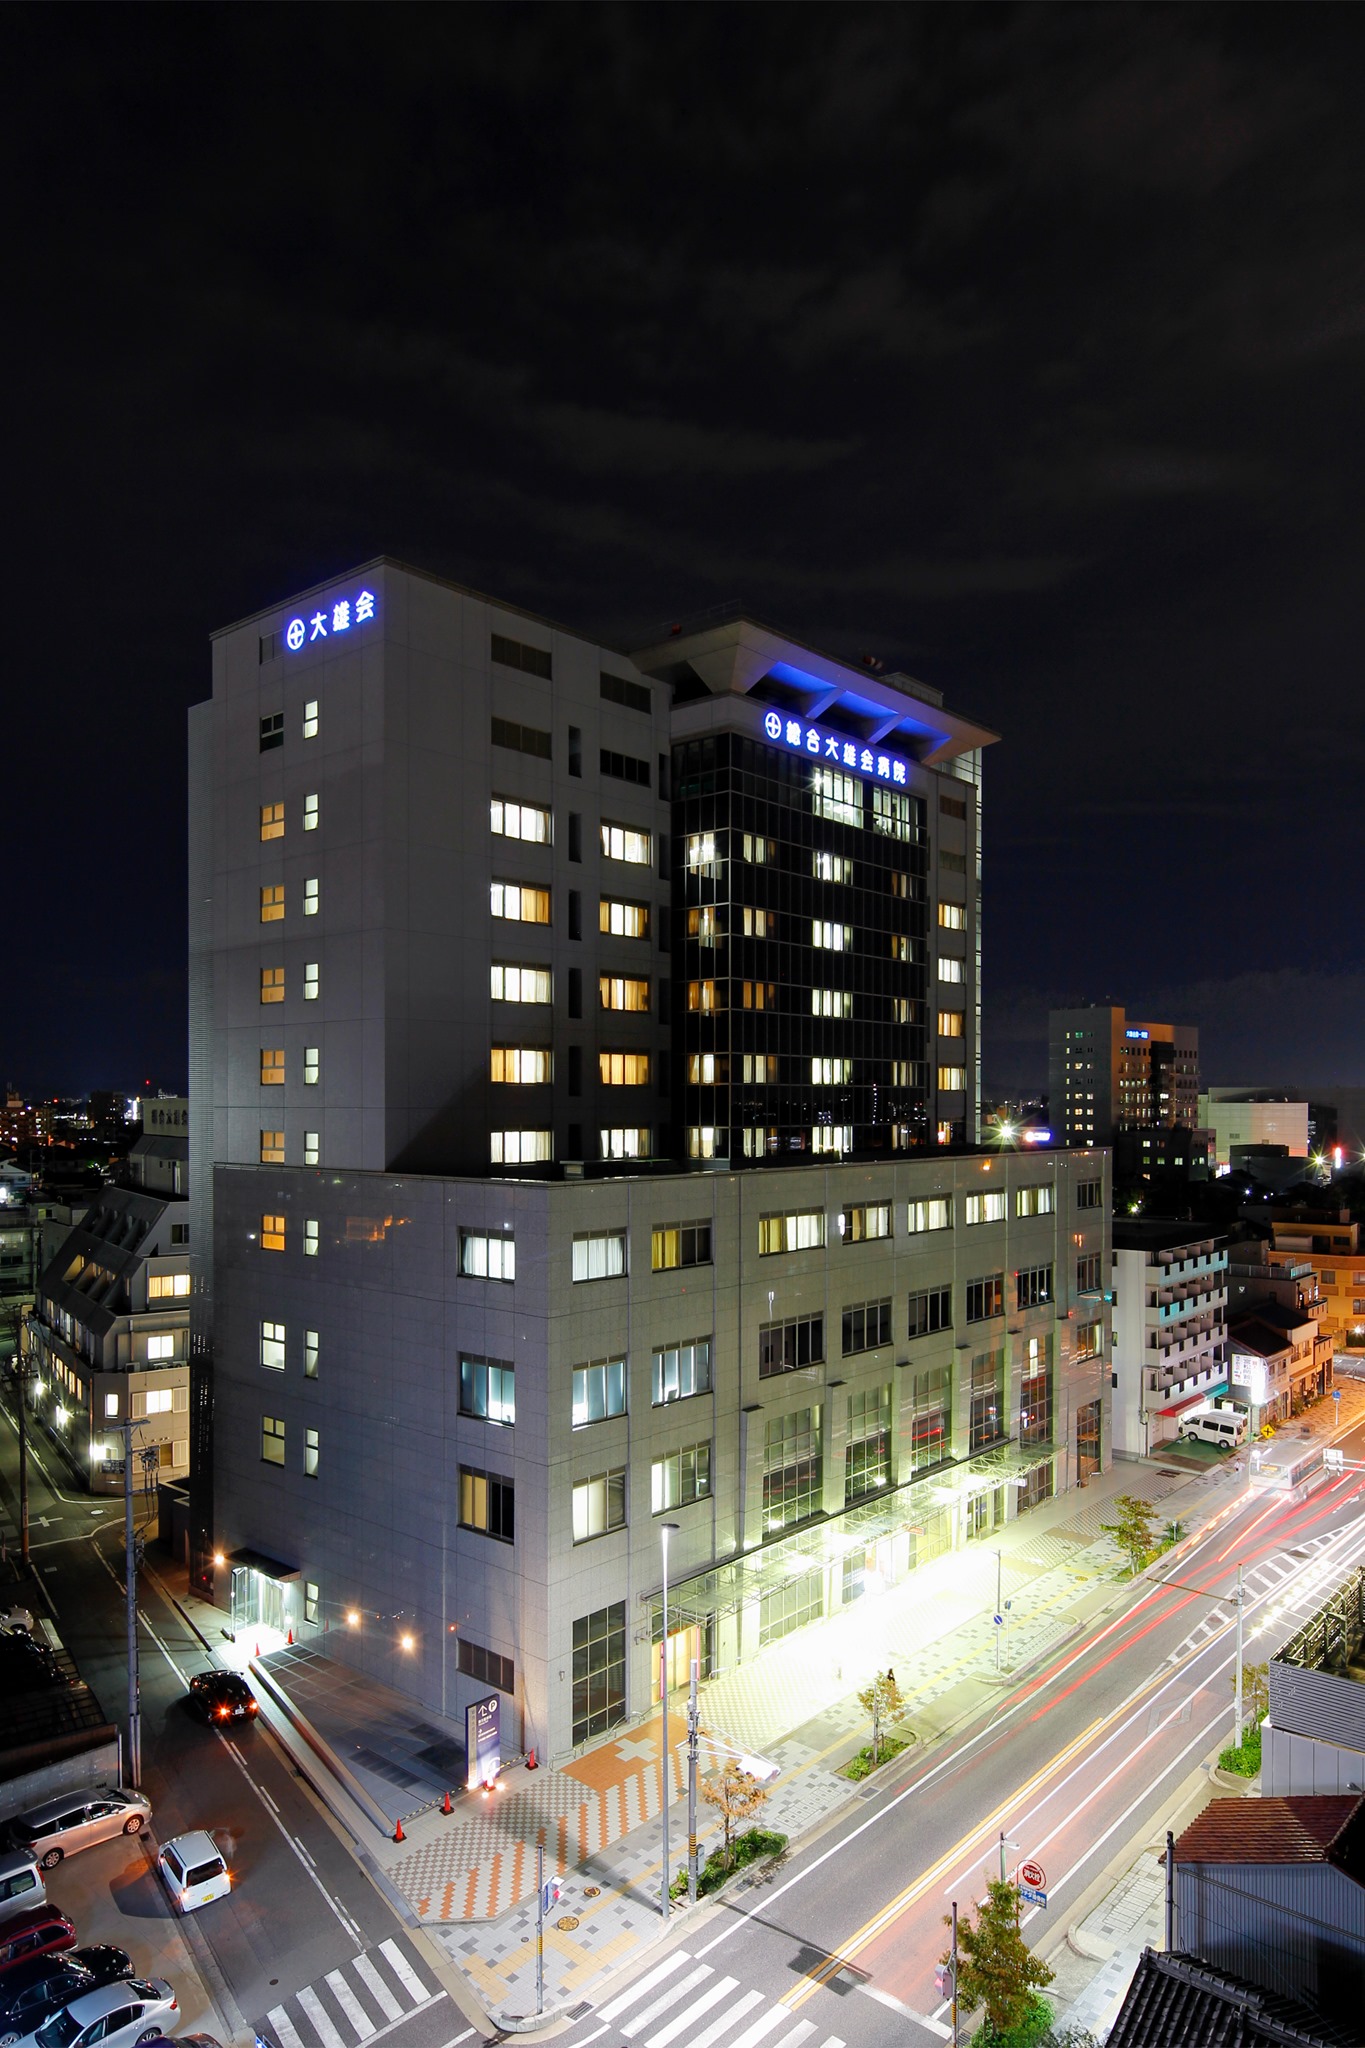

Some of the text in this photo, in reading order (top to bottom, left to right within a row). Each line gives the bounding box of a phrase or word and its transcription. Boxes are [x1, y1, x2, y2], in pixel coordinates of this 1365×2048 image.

[310, 591, 375, 641] 大雄会
[1024, 1869, 1040, 1882] 消火栓
